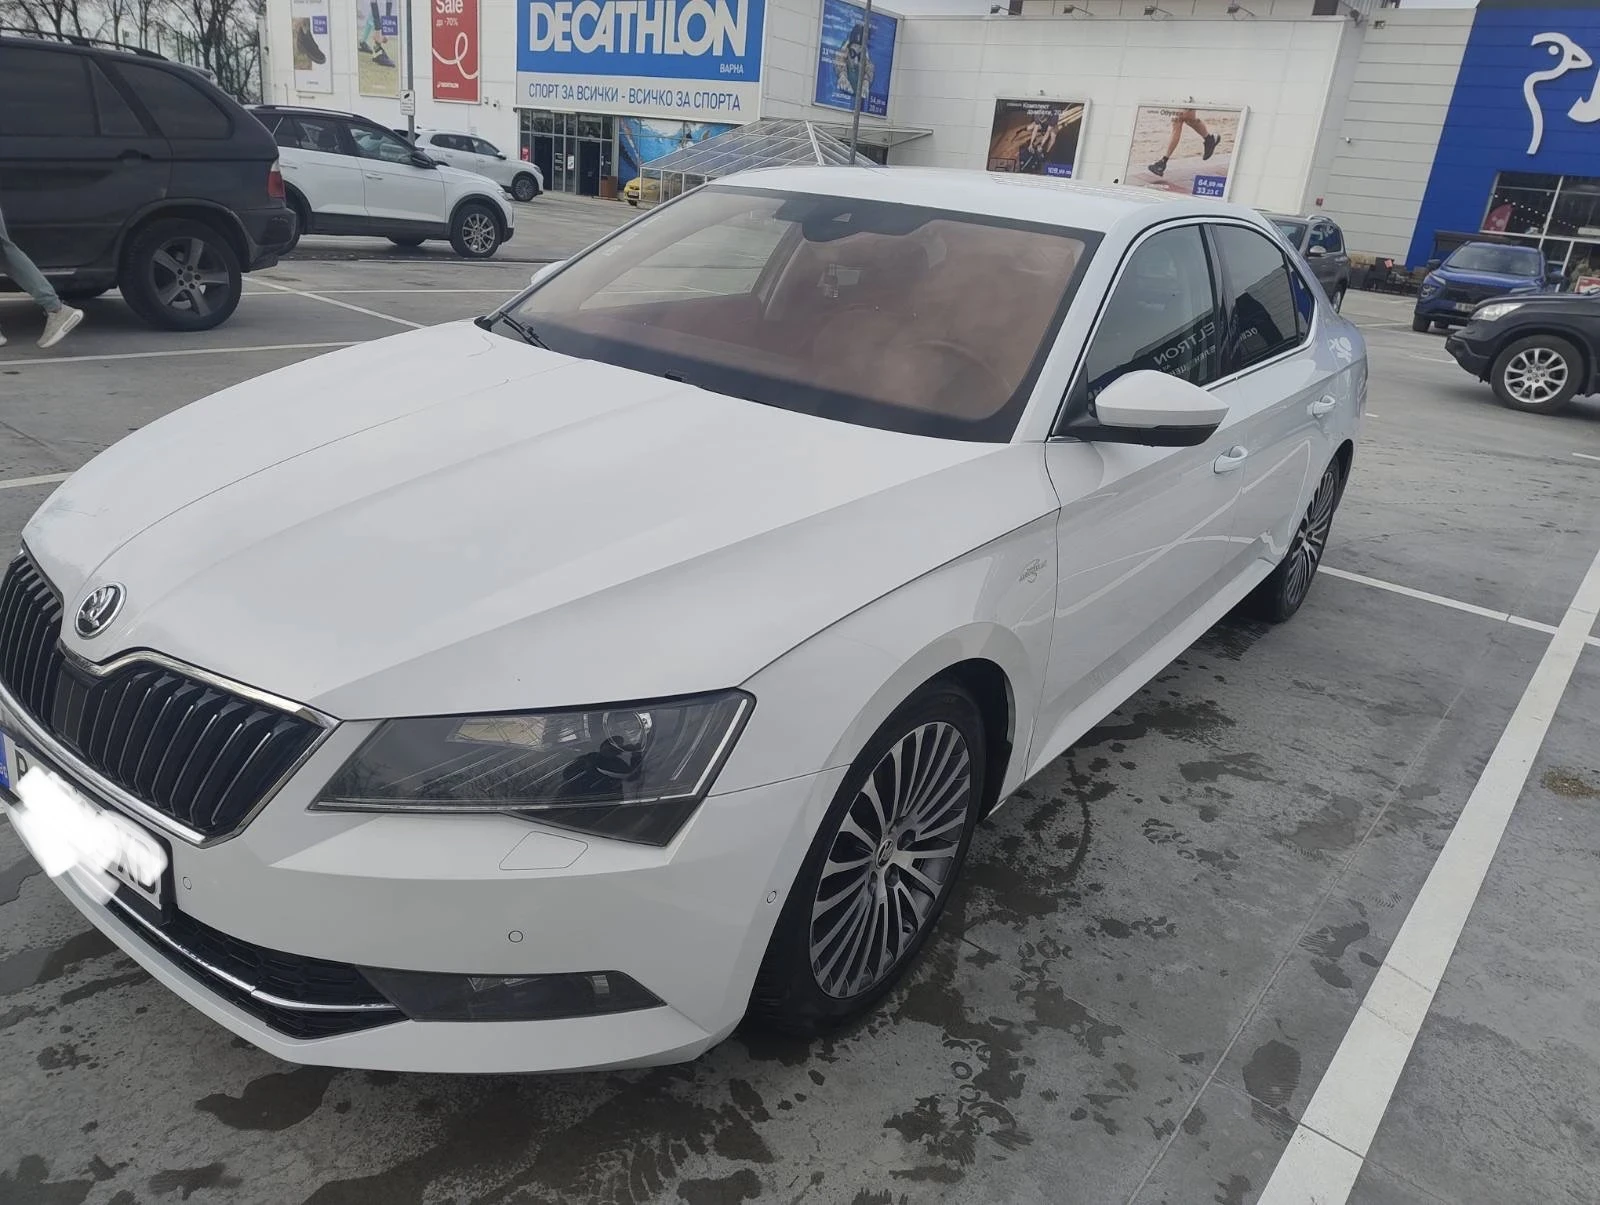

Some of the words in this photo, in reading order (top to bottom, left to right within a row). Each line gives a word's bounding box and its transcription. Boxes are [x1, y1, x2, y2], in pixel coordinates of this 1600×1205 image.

[436, 0, 463, 13] Sale
[530, 0, 749, 56] DECATHLON
[719, 63, 744, 74] ВАРНА
[529, 83, 559, 99] СПОРТ
[562, 84, 574, 100] ЗА
[577, 85, 619, 103] ВСИЧКИ
[628, 87, 673, 107] ВСИЧКО
[676, 90, 690, 107] ЗА
[694, 91, 741, 111] СПОРТА
